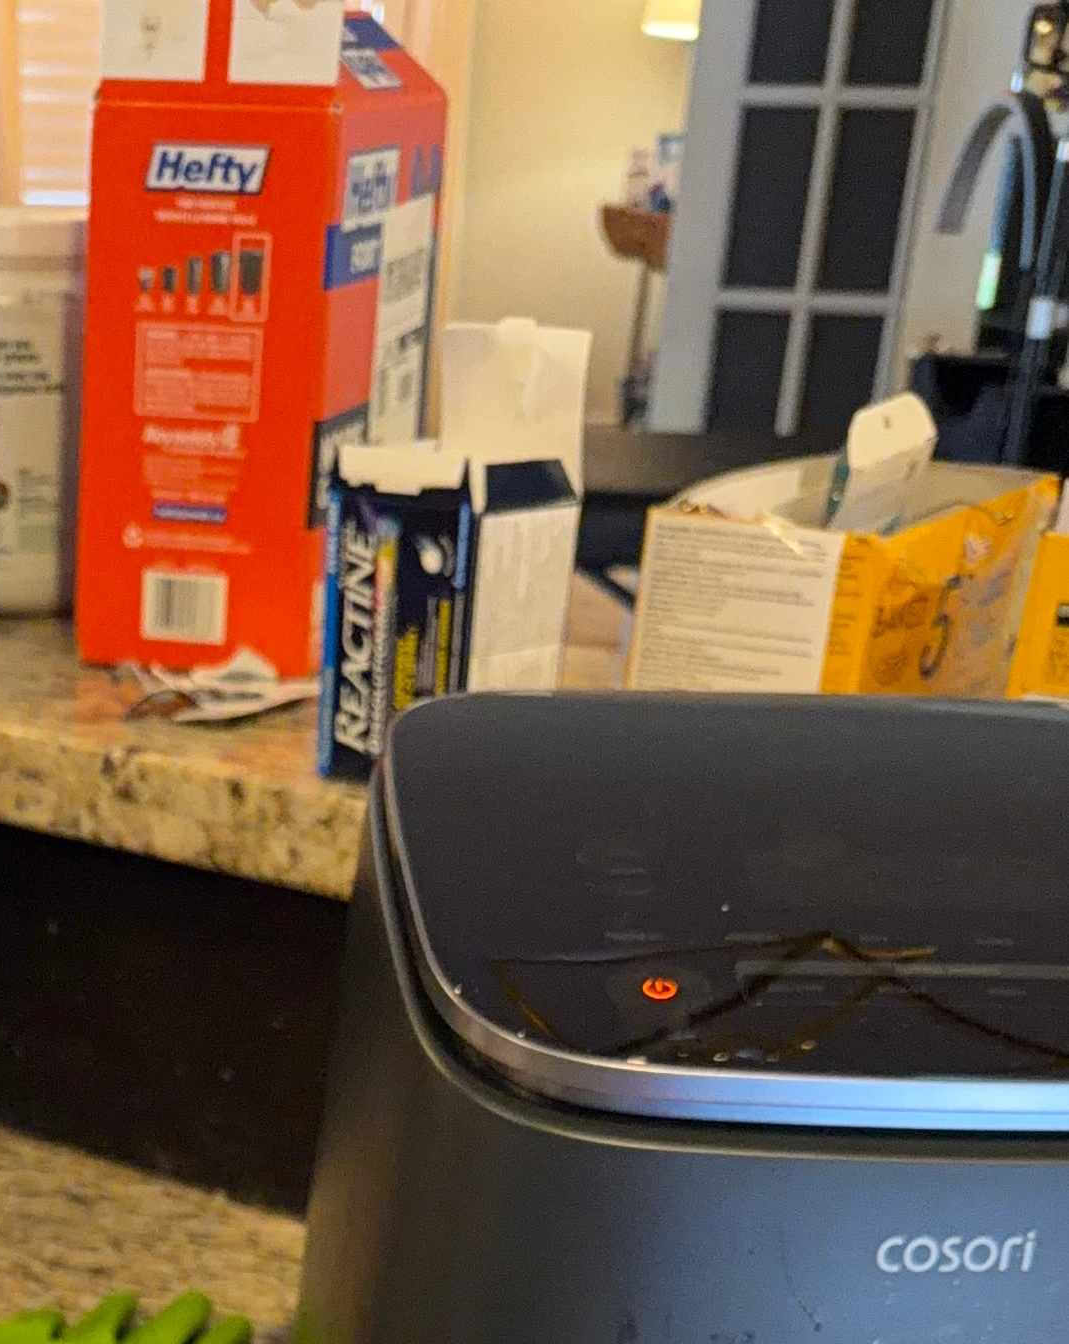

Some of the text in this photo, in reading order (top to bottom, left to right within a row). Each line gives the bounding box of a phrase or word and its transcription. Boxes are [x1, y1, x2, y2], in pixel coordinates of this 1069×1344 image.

[155, 150, 258, 192] Hefty
[334, 518, 378, 753] REACTINE
[876, 1230, 1038, 1273] cosori
